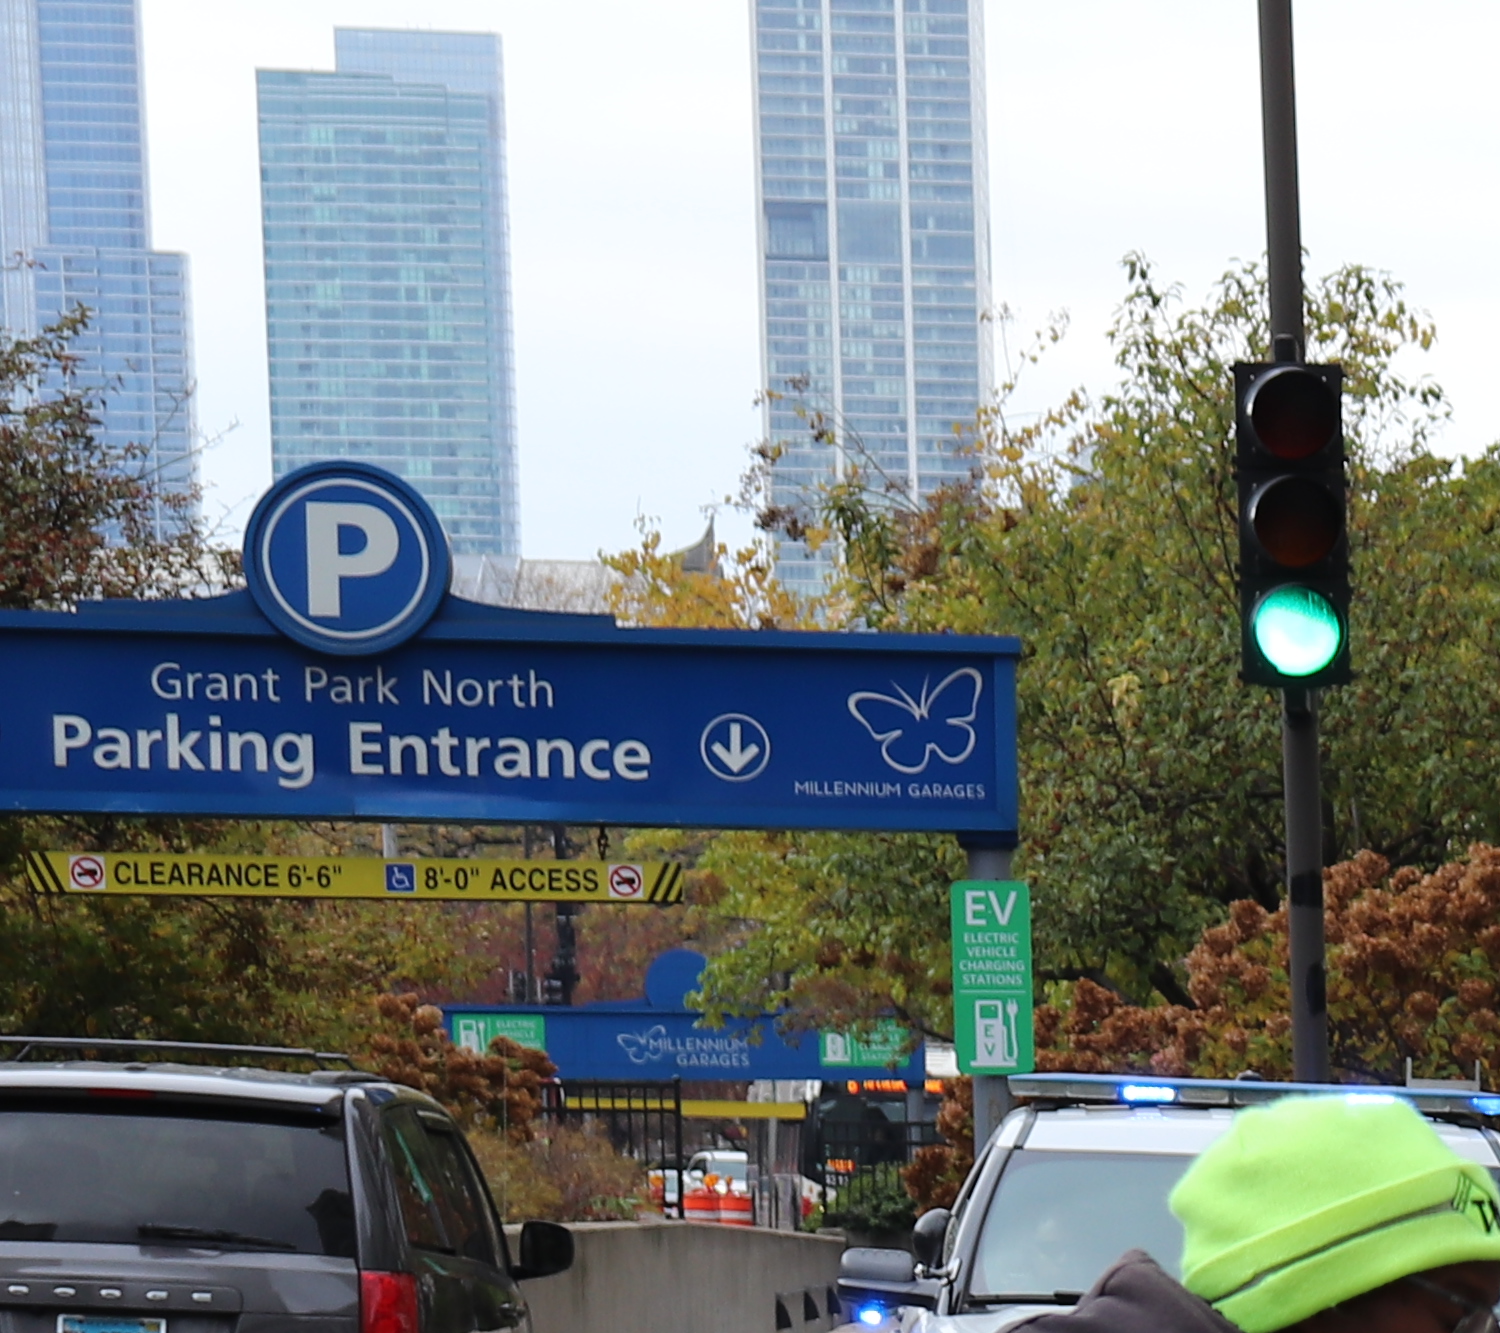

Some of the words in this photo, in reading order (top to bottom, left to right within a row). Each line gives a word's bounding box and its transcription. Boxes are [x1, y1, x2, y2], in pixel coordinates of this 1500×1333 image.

[305, 501, 399, 617] P
[150, 662, 281, 702] Grant
[304, 665, 400, 705] Park
[422, 669, 554, 708] North
[51, 712, 315, 789] Parking
[348, 721, 651, 780] Entrance
[794, 780, 901, 798] MILLENNIUM
[908, 783, 985, 799] GARAGES
[113, 861, 279, 888] CLEARANCE
[490, 868, 599, 891] ACCESS
[964, 890, 1018, 926] EV
[963, 932, 1019, 944] ELECTRIC
[965, 946, 1017, 957] VEHICLE
[959, 960, 1025, 972] CHARGING
[962, 974, 1023, 986] STATIONS
[649, 1037, 748, 1052] MILLENNIUM
[676, 1053, 750, 1067] GARAGES
